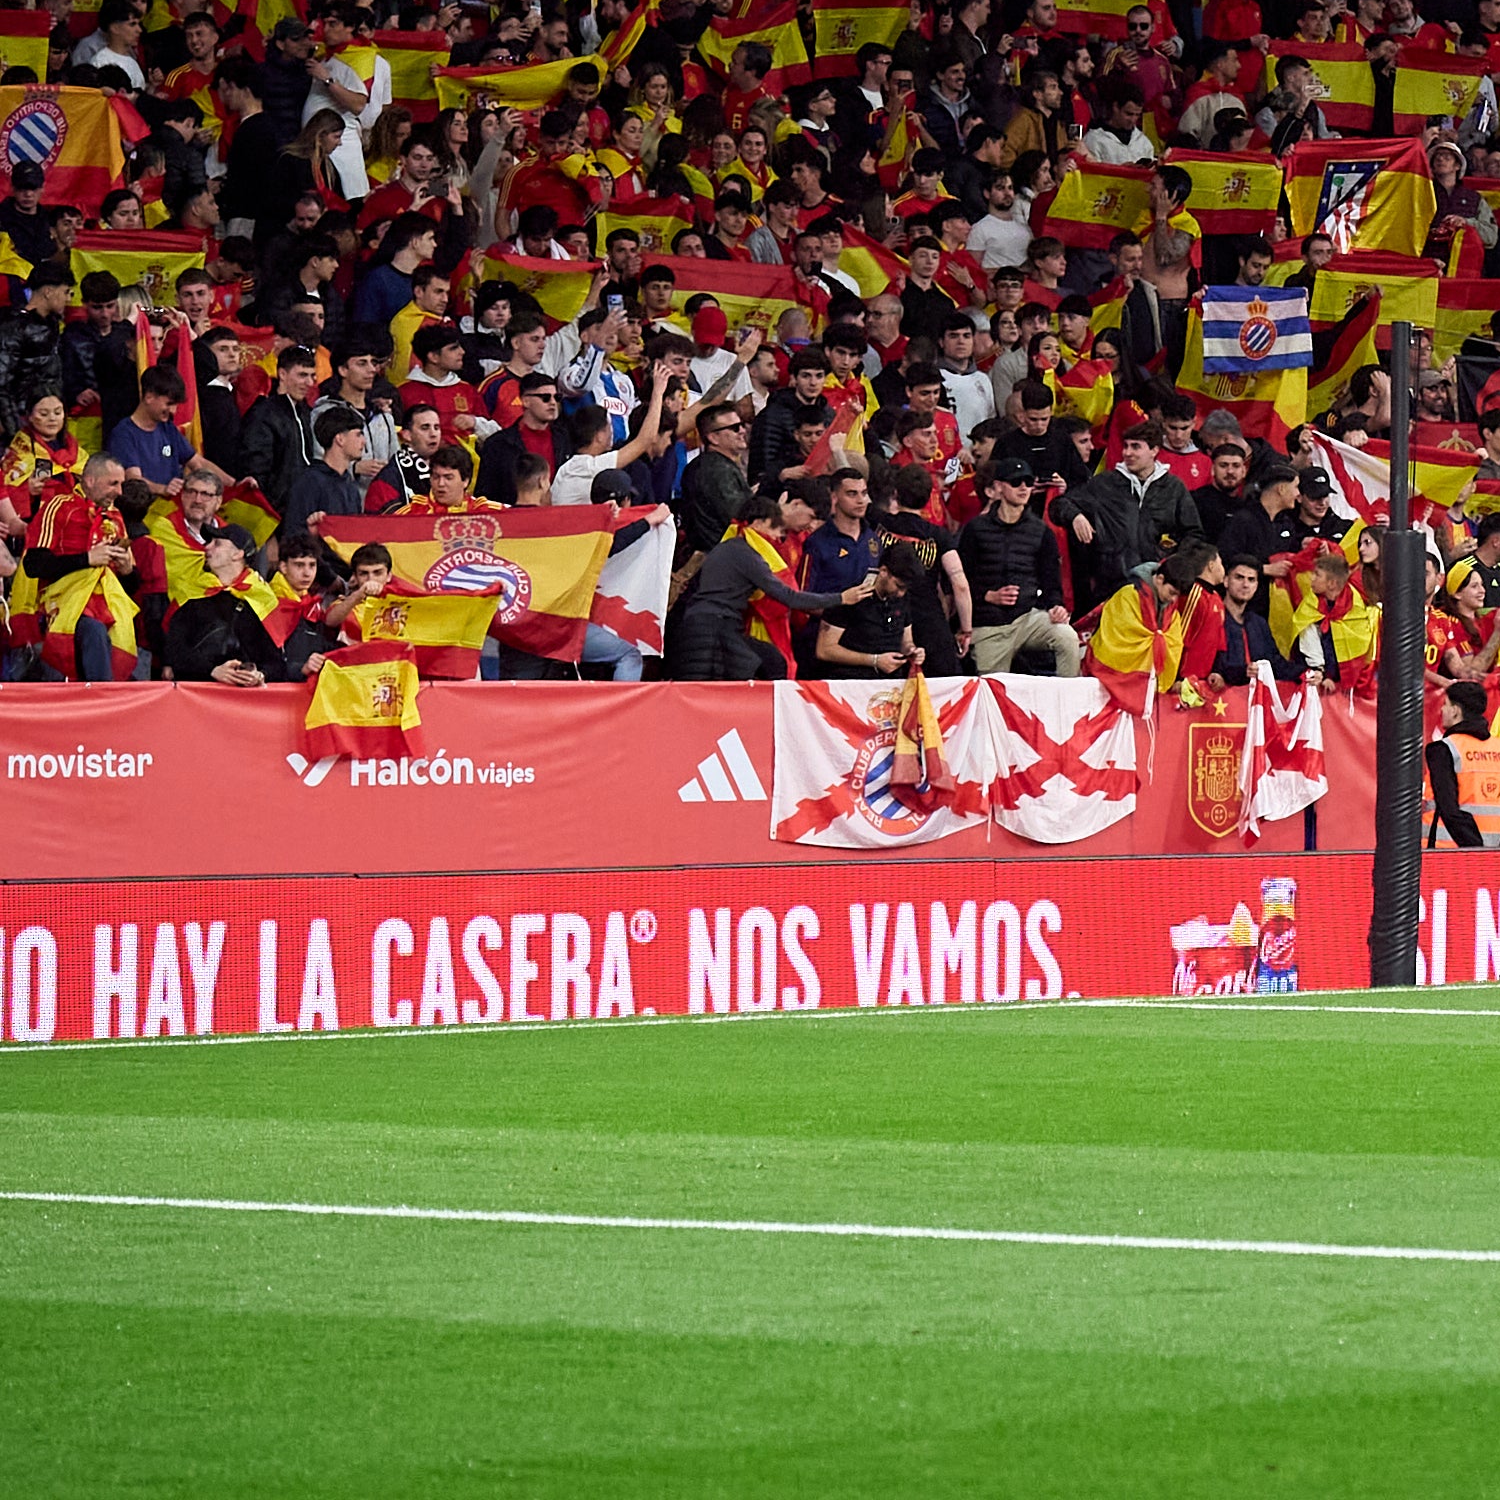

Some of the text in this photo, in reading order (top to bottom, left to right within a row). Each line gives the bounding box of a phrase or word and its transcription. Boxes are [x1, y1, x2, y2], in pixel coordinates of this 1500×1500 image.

[7, 744, 153, 779] movistar
[350, 748, 536, 788] Halcón viajes
[0, 924, 58, 1042] O
[93, 919, 227, 1041] HAY
[258, 917, 340, 1033] LA
[687, 905, 822, 1016] NOS
